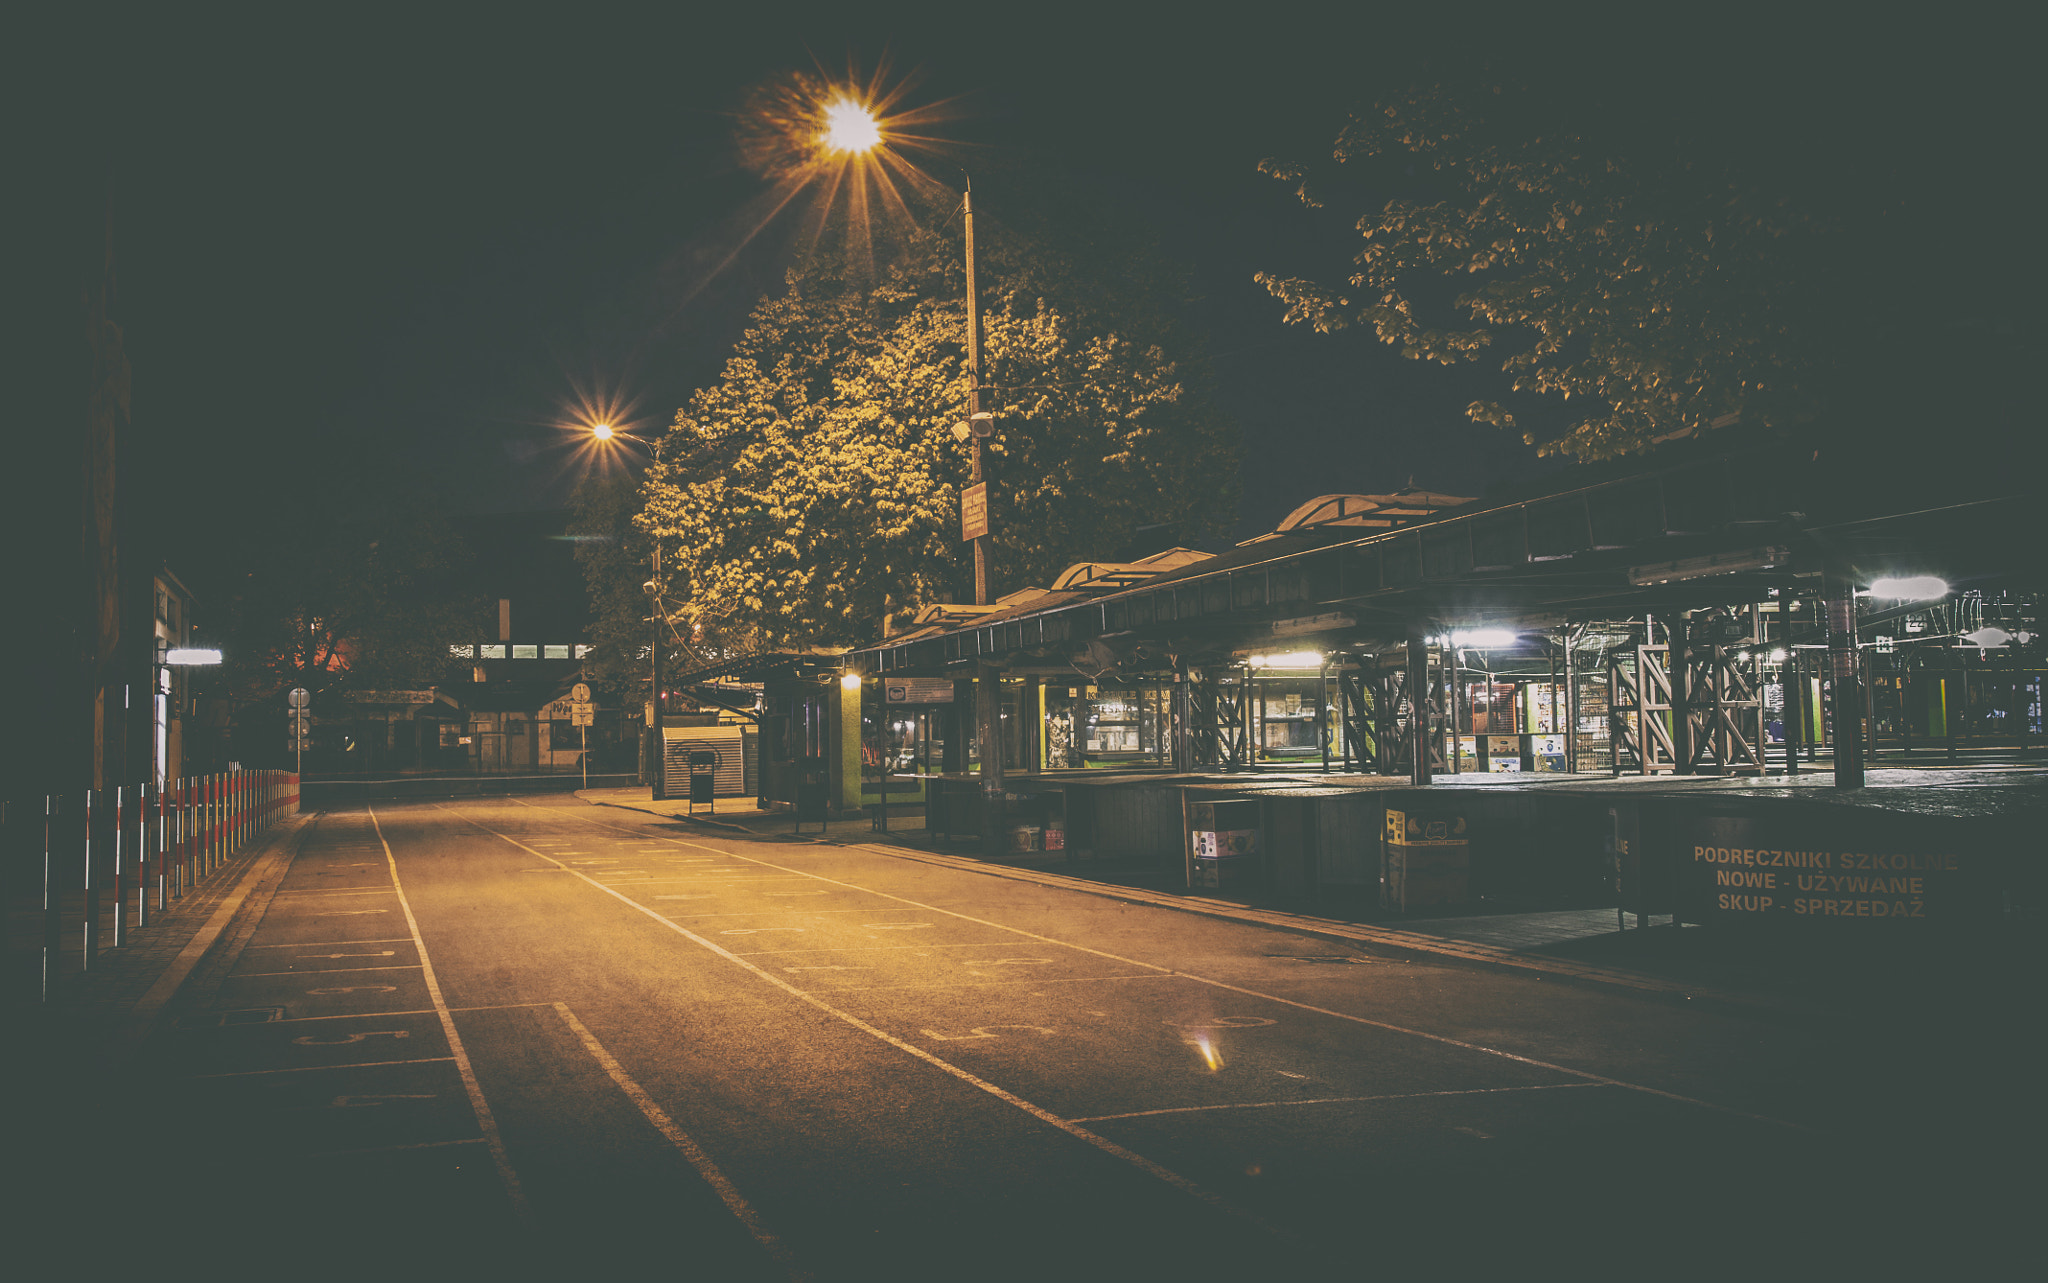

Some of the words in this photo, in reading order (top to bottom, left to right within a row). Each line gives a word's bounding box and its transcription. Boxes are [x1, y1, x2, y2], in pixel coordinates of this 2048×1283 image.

[1694, 846, 1831, 868] PODRĘCZNIKI
[1840, 852, 1958, 871] SZKOLNE
[1717, 870, 1776, 889] NOWE
[1797, 870, 1924, 894] UŻYWANE
[1718, 893, 1773, 912] SKUP
[1794, 896, 1926, 918] SPRZEDAŻ
